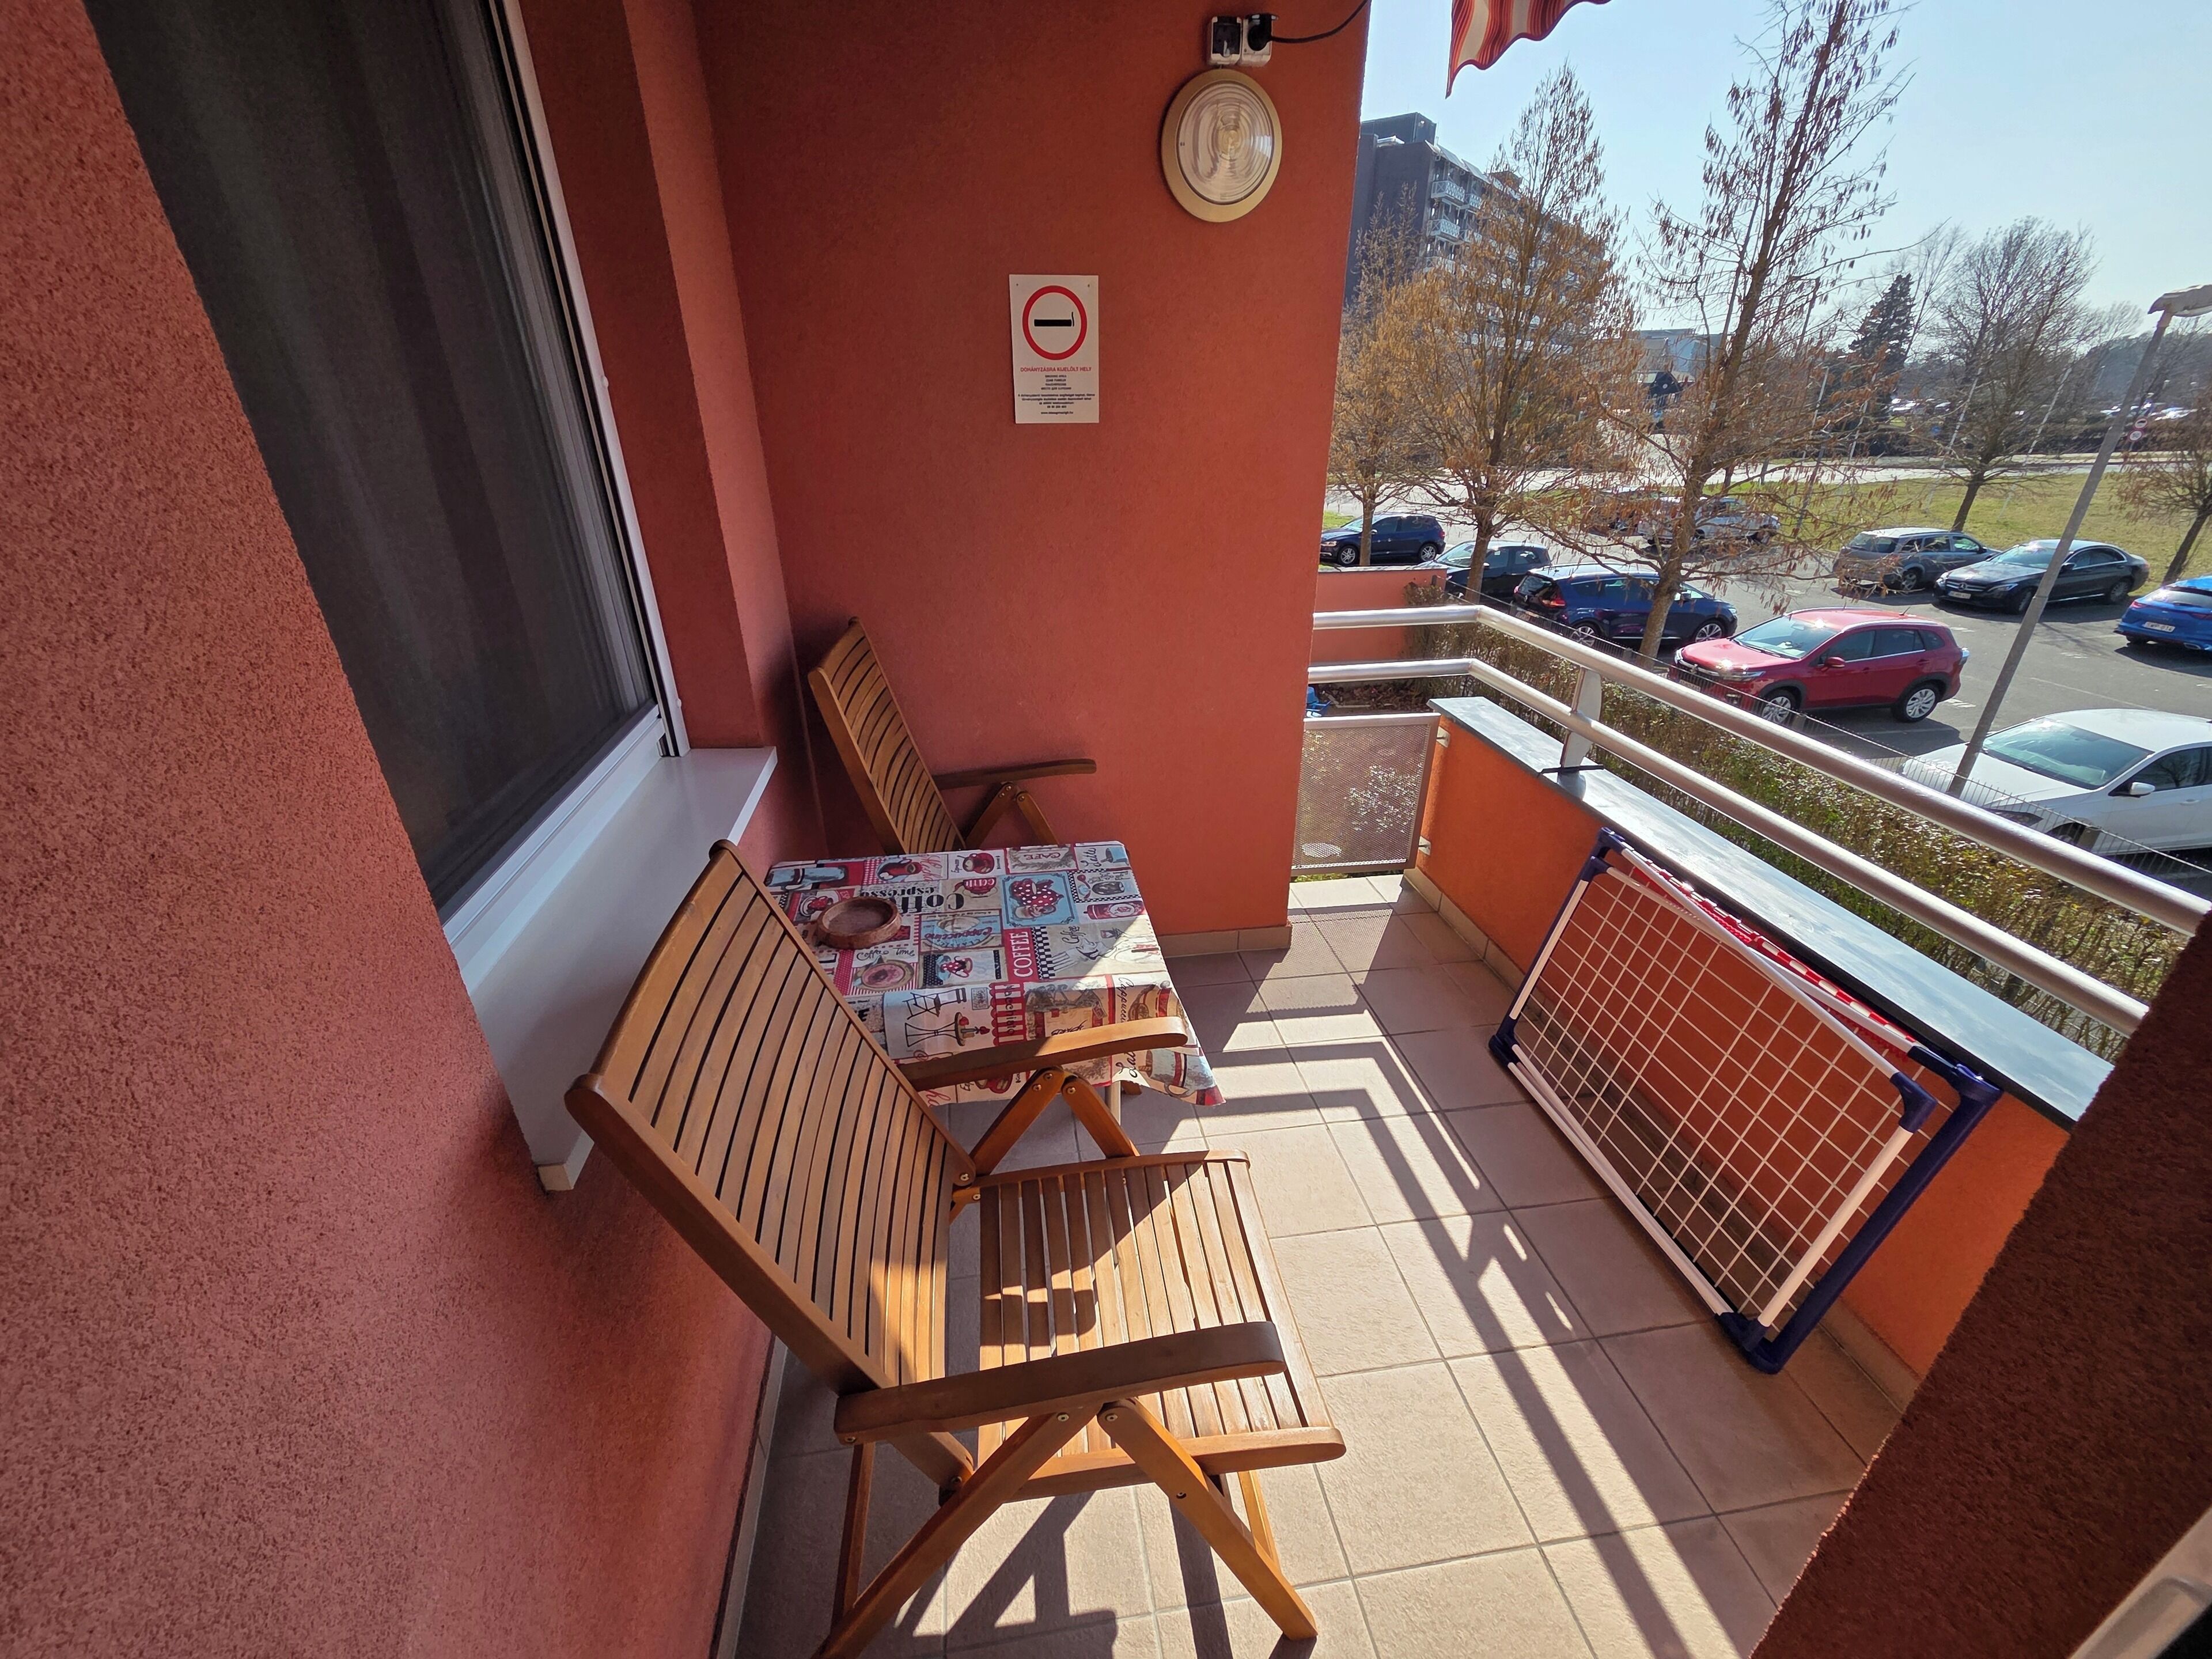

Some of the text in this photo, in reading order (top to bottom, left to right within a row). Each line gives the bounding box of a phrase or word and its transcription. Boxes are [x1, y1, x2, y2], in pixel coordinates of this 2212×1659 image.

[889, 893, 964, 915] Coff
[892, 947, 915, 956] Time
[1009, 931, 1033, 978] COFFEE
